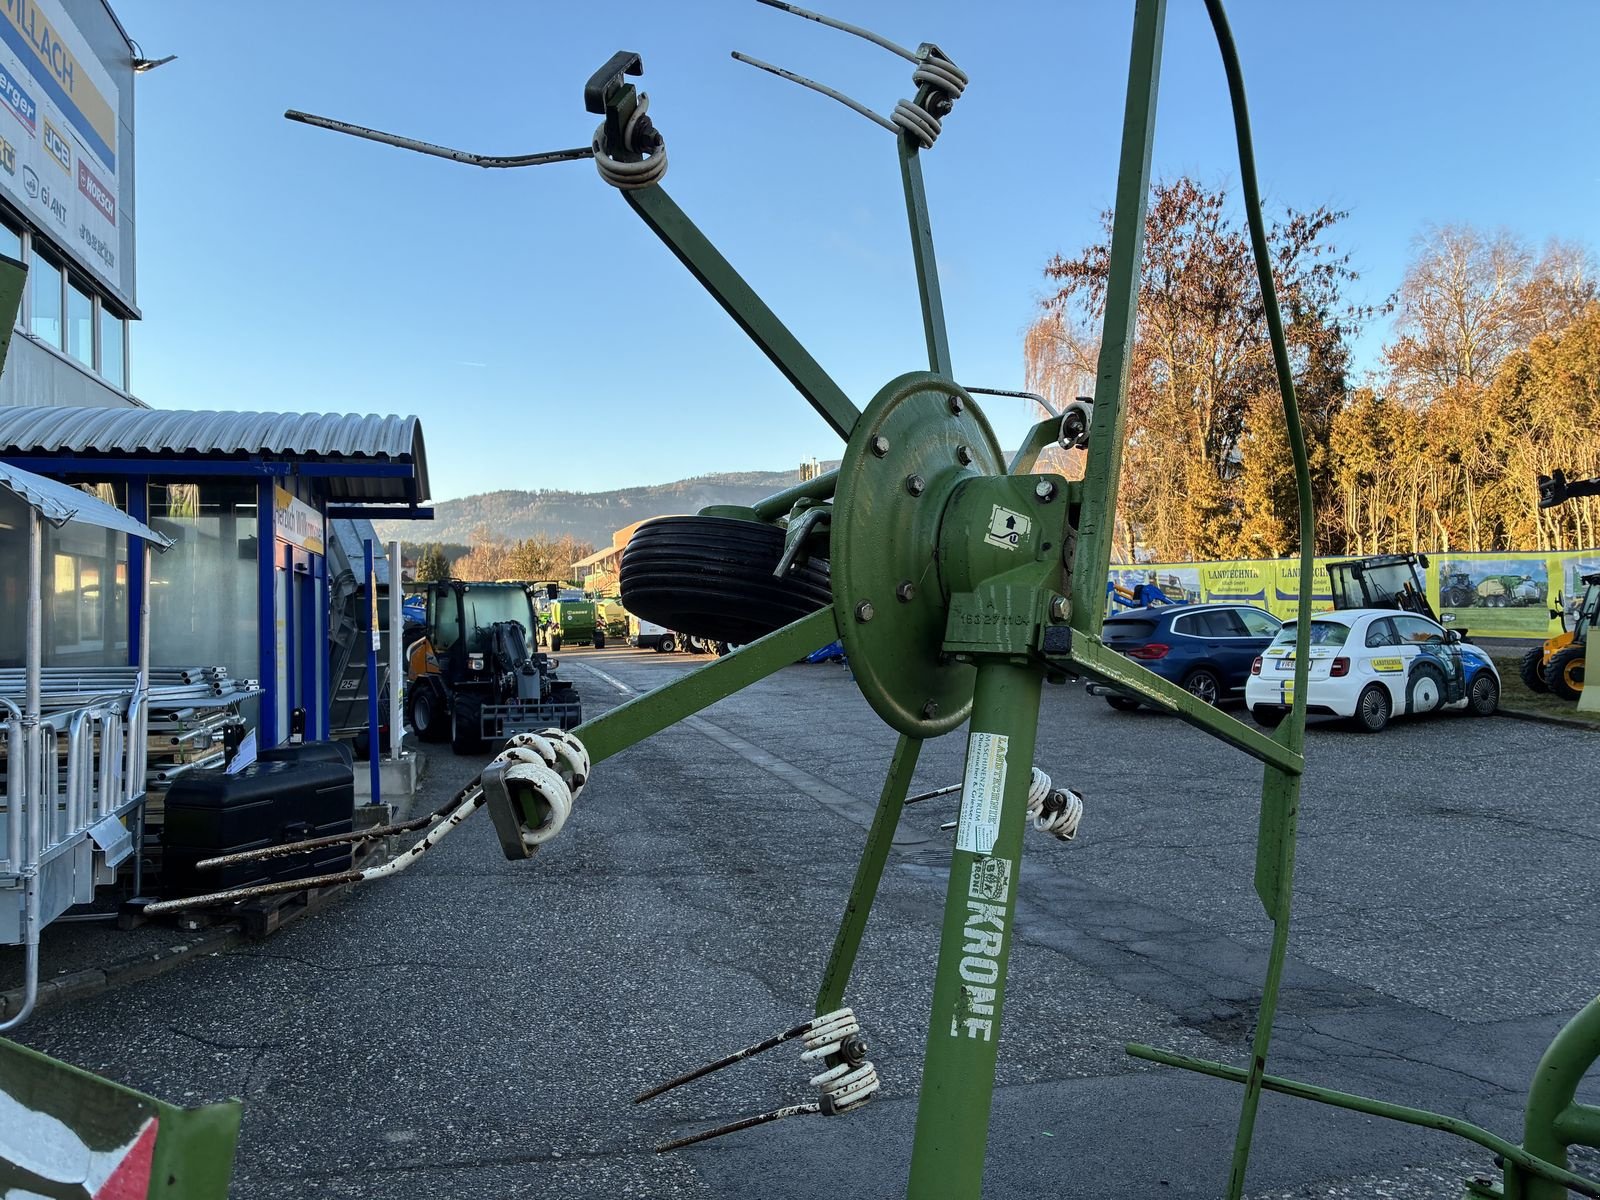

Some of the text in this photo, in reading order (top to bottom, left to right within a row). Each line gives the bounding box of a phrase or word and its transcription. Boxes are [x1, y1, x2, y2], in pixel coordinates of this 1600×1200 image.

[44, 130, 70, 172] JCB
[86, 176, 114, 217] HORSCH
[1208, 569, 1259, 579] LANDTECHNIK
[975, 734, 991, 821] MASCHINENZENTRUM
[988, 736, 1007, 825] LANDTECHNIK
[971, 862, 982, 895] RONE
[951, 900, 1007, 1042] KRONE
